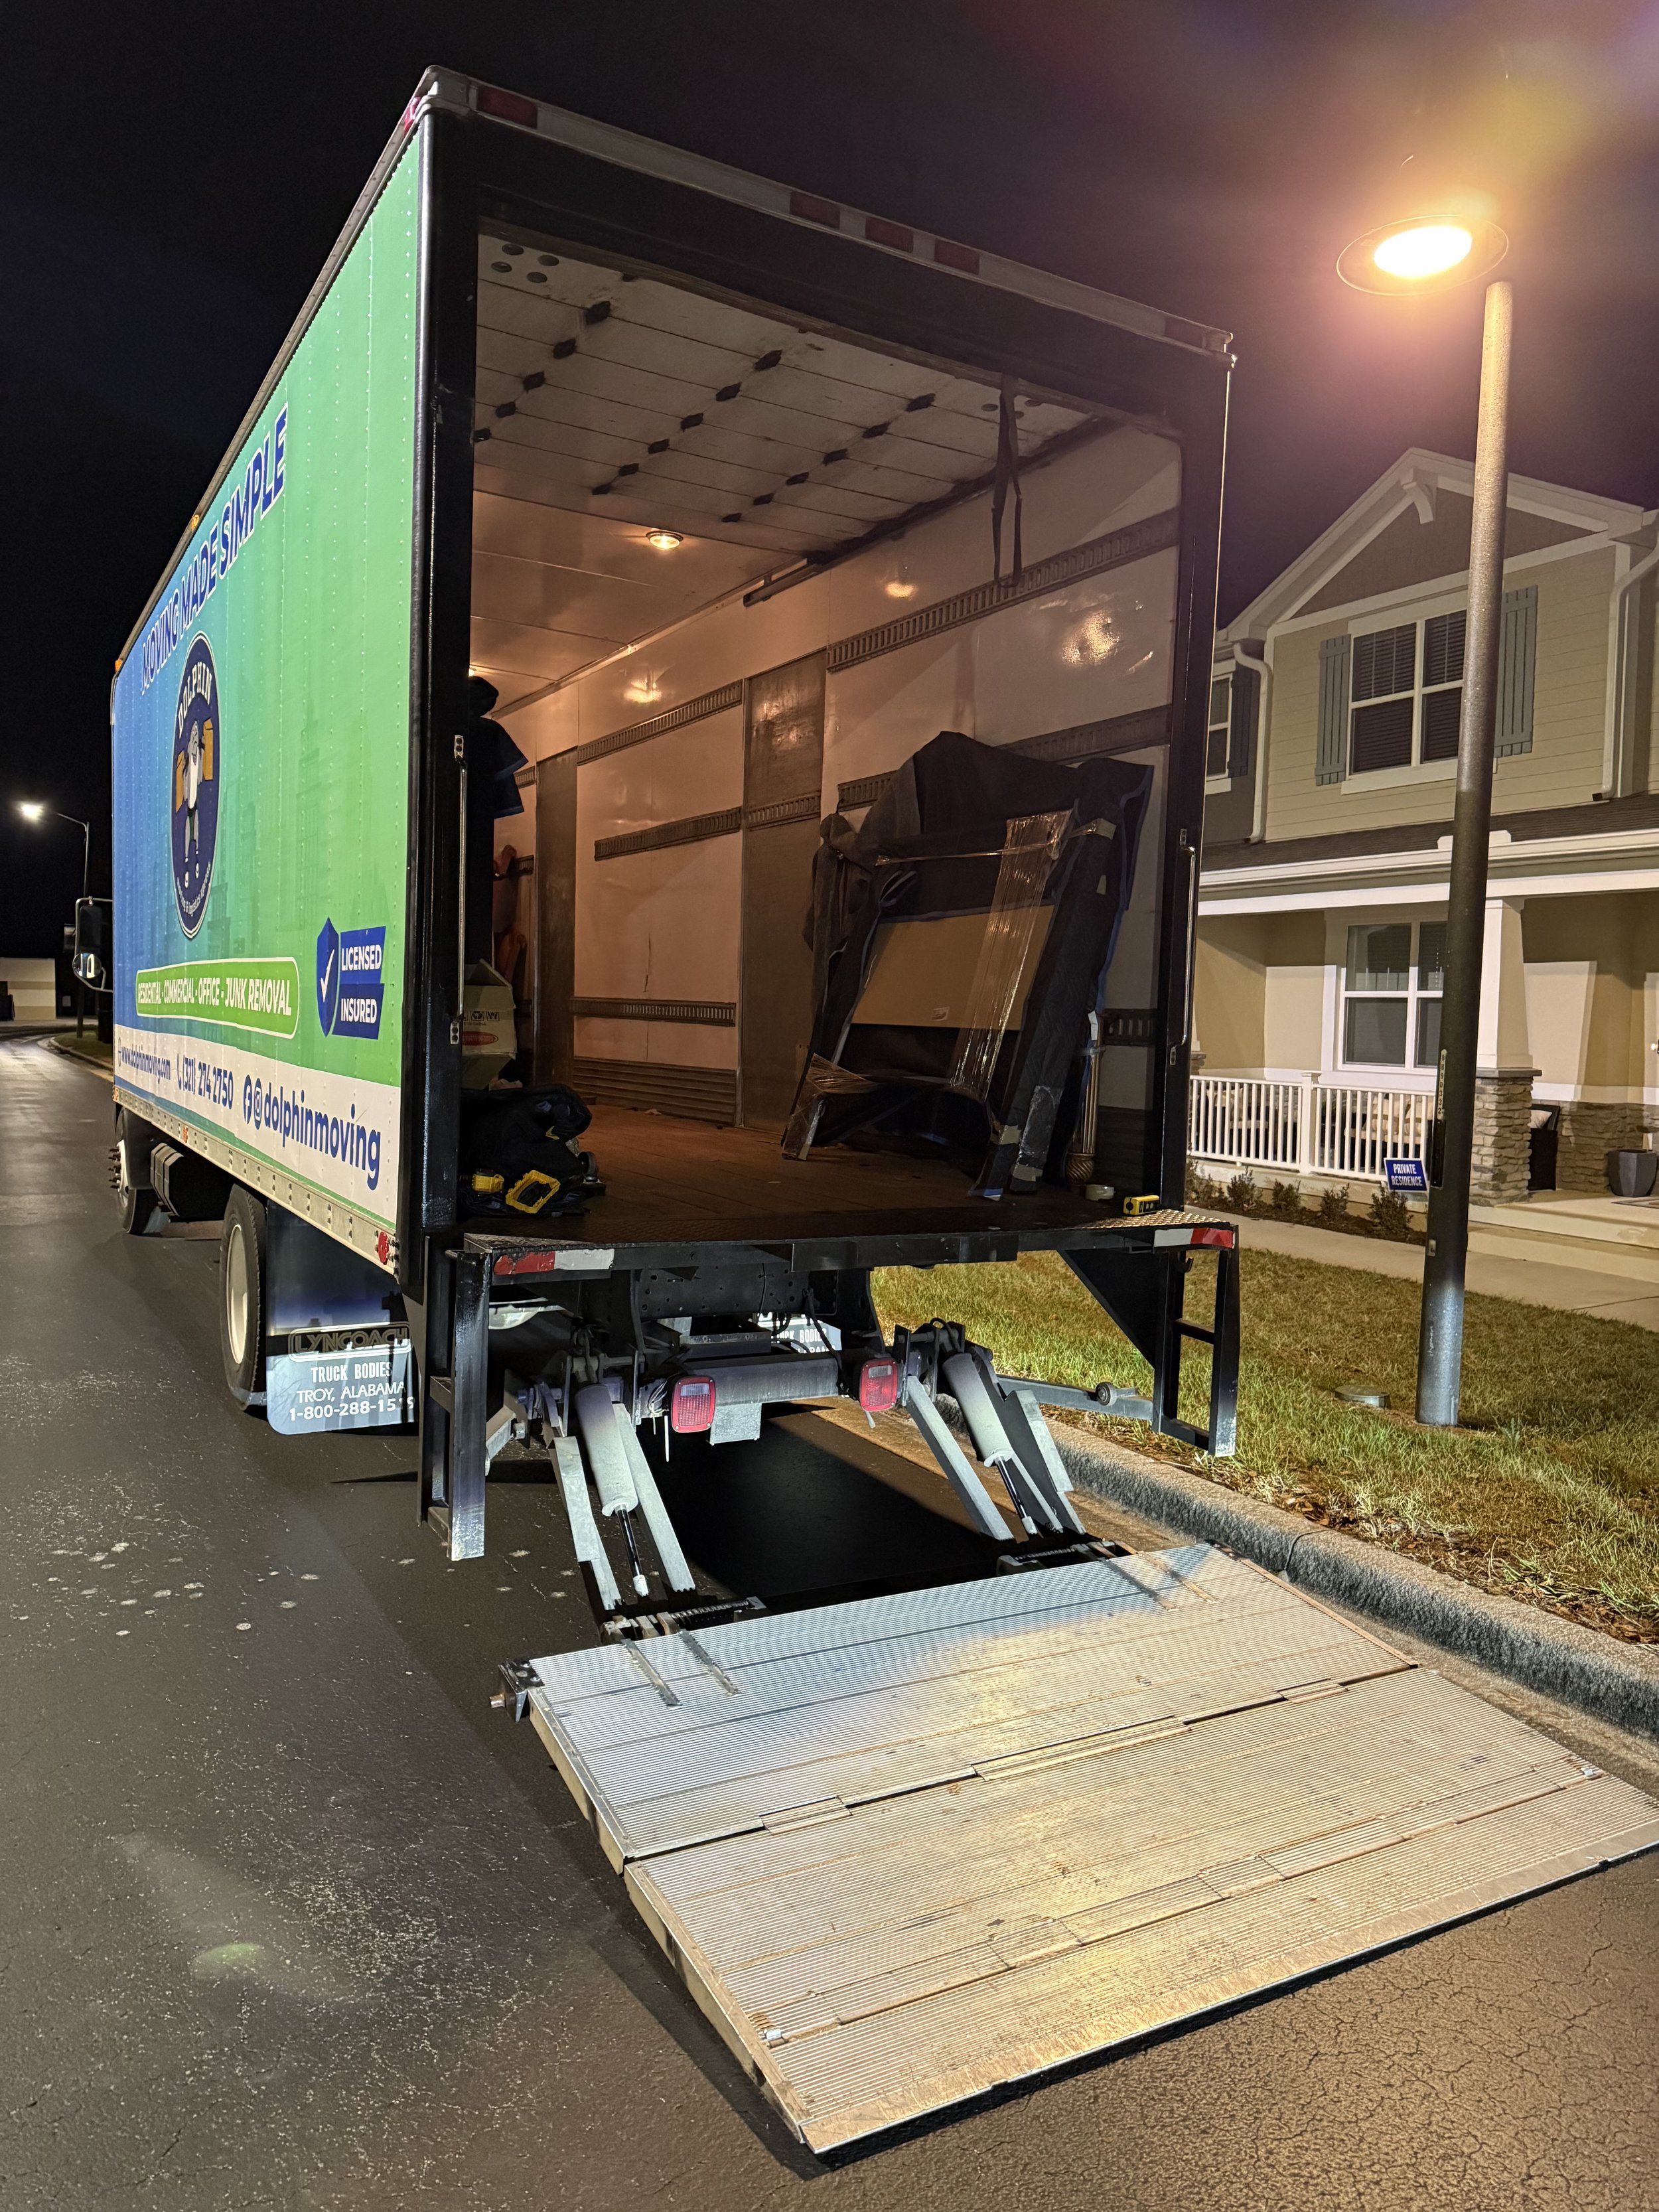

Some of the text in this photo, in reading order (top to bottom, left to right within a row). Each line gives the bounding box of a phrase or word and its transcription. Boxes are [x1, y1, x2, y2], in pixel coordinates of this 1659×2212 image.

[141, 401, 288, 696] MOVING MADE SIMPLE
[178, 661, 212, 739] DOLPHIN
[341, 944, 382, 971] LICENSED
[137, 977, 291, 1016] RESIDENTIAL COMMERCIAL OFFICE JUNK REMOVAL
[340, 997, 378, 1023] INSURED
[182, 1055, 234, 1110] (321) 274 2750
[264, 1082, 381, 1191] dolphinmoving
[1391, 1175, 1423, 1187] RESIDENCE
[1393, 1163, 1417, 1175] PRIVATE
[294, 1327, 408, 1354] LYNCOACH
[311, 1361, 392, 1383] TRUCK BODIES
[297, 1381, 406, 1404] TROY, ALABAMA
